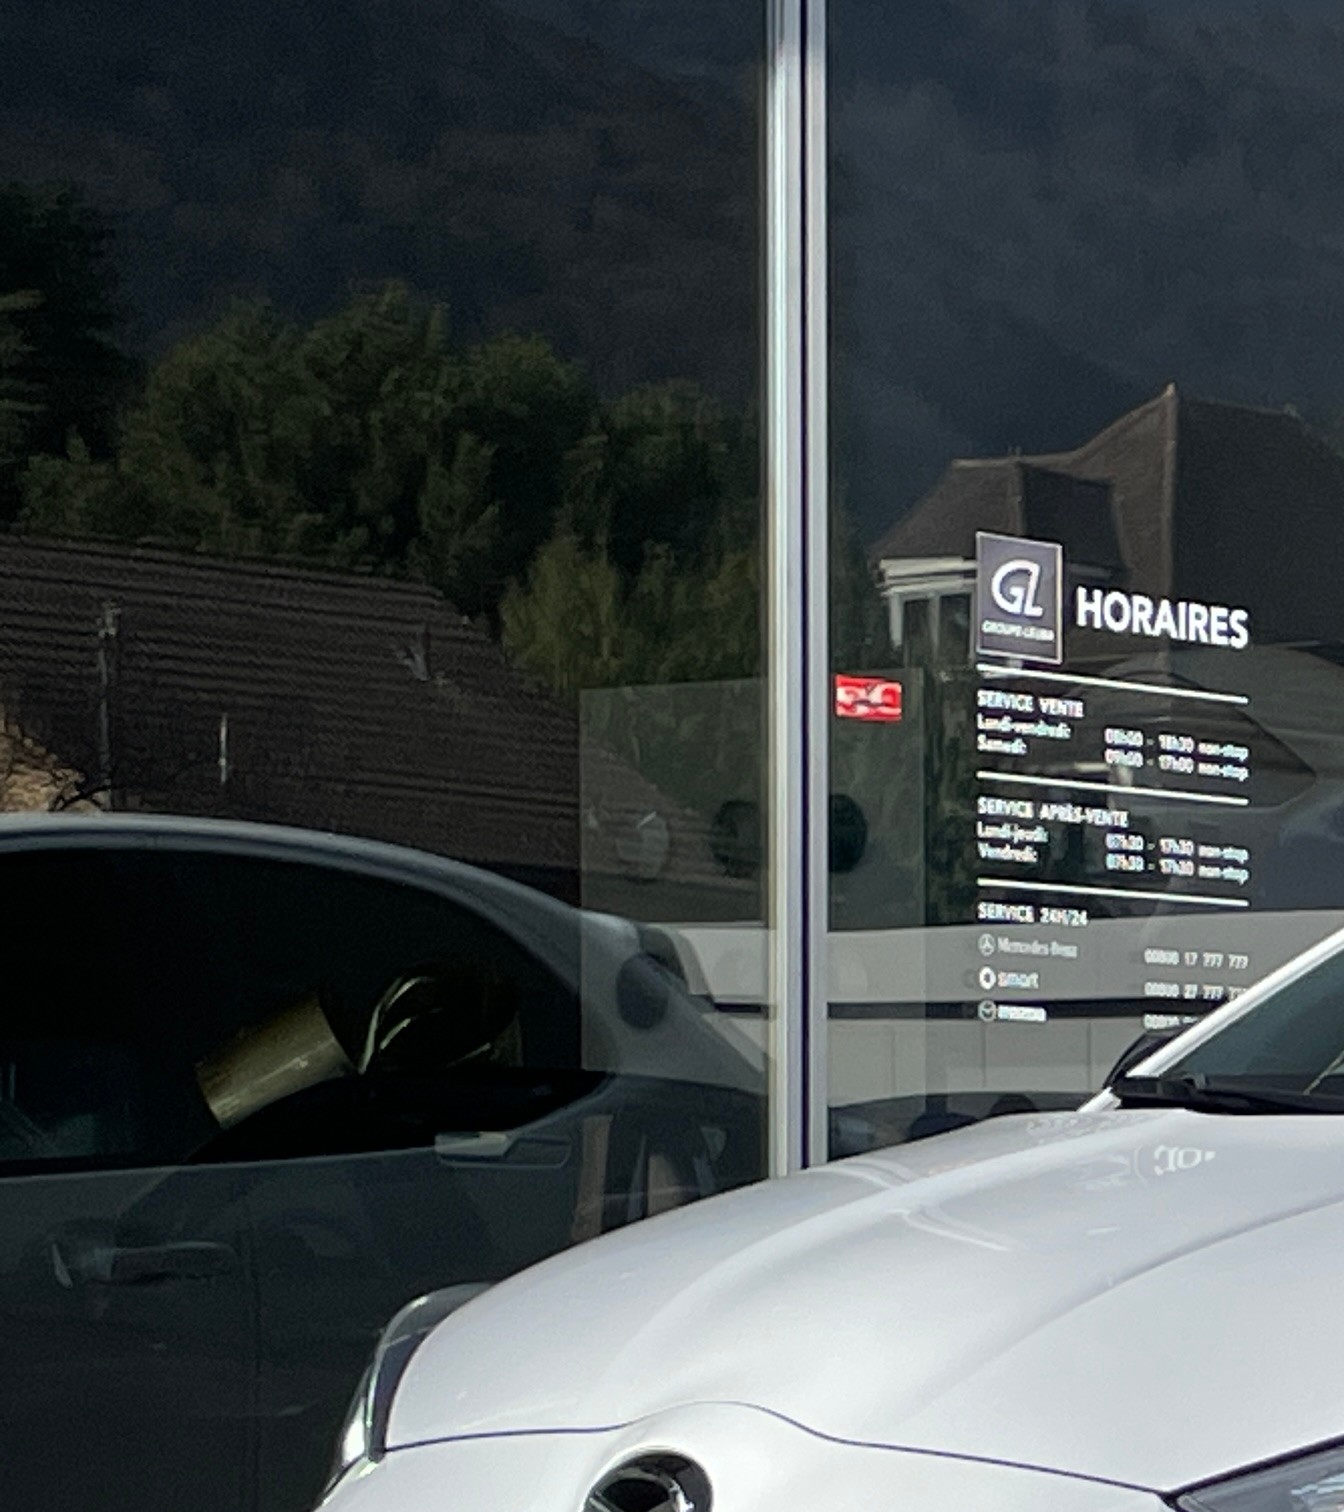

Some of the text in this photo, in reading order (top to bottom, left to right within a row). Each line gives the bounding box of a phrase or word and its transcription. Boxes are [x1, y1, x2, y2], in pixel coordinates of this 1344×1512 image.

[991, 559, 1043, 617] GL
[1076, 585, 1249, 649] HORAIRES
[977, 689, 1084, 718] SERVICE VENTE
[977, 796, 1033, 818] SERVICE
[978, 902, 1035, 923] SERVICE
